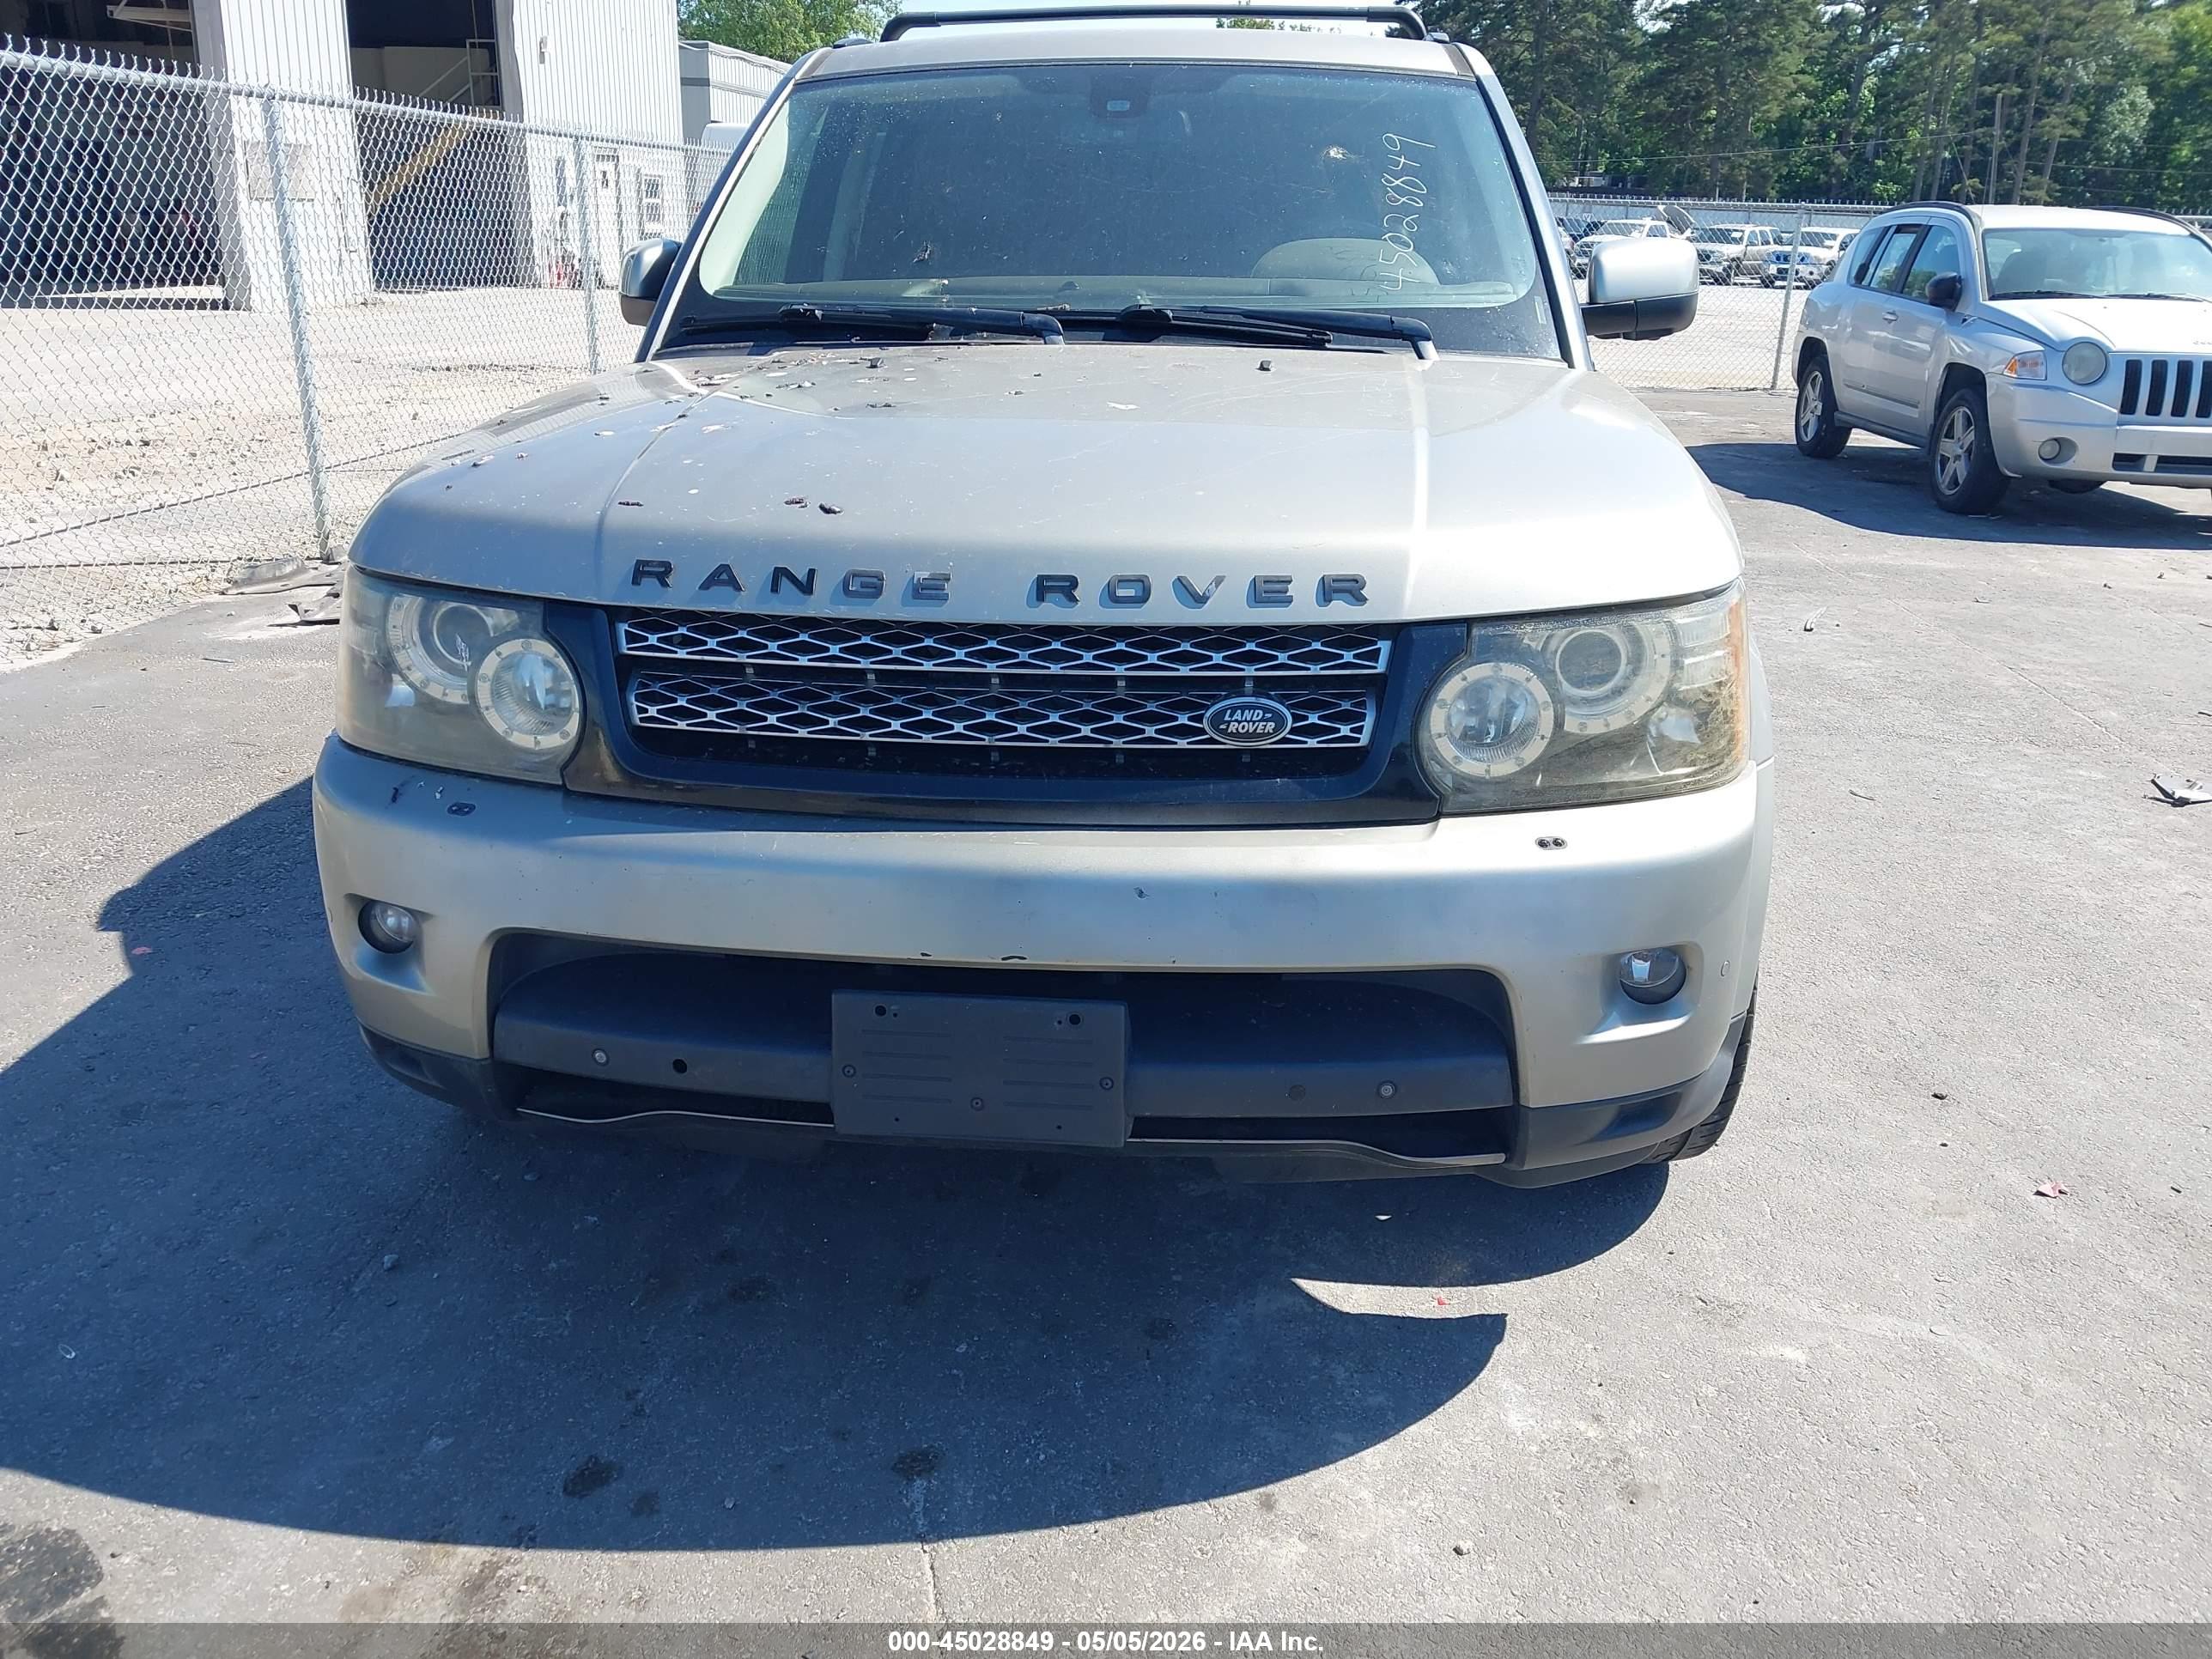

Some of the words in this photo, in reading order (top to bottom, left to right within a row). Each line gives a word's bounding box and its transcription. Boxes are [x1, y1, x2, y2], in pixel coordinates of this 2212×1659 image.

[1379, 133, 1437, 290] 45028849
[631, 558, 953, 601] RANGE
[1036, 574, 1369, 605] ROVER
